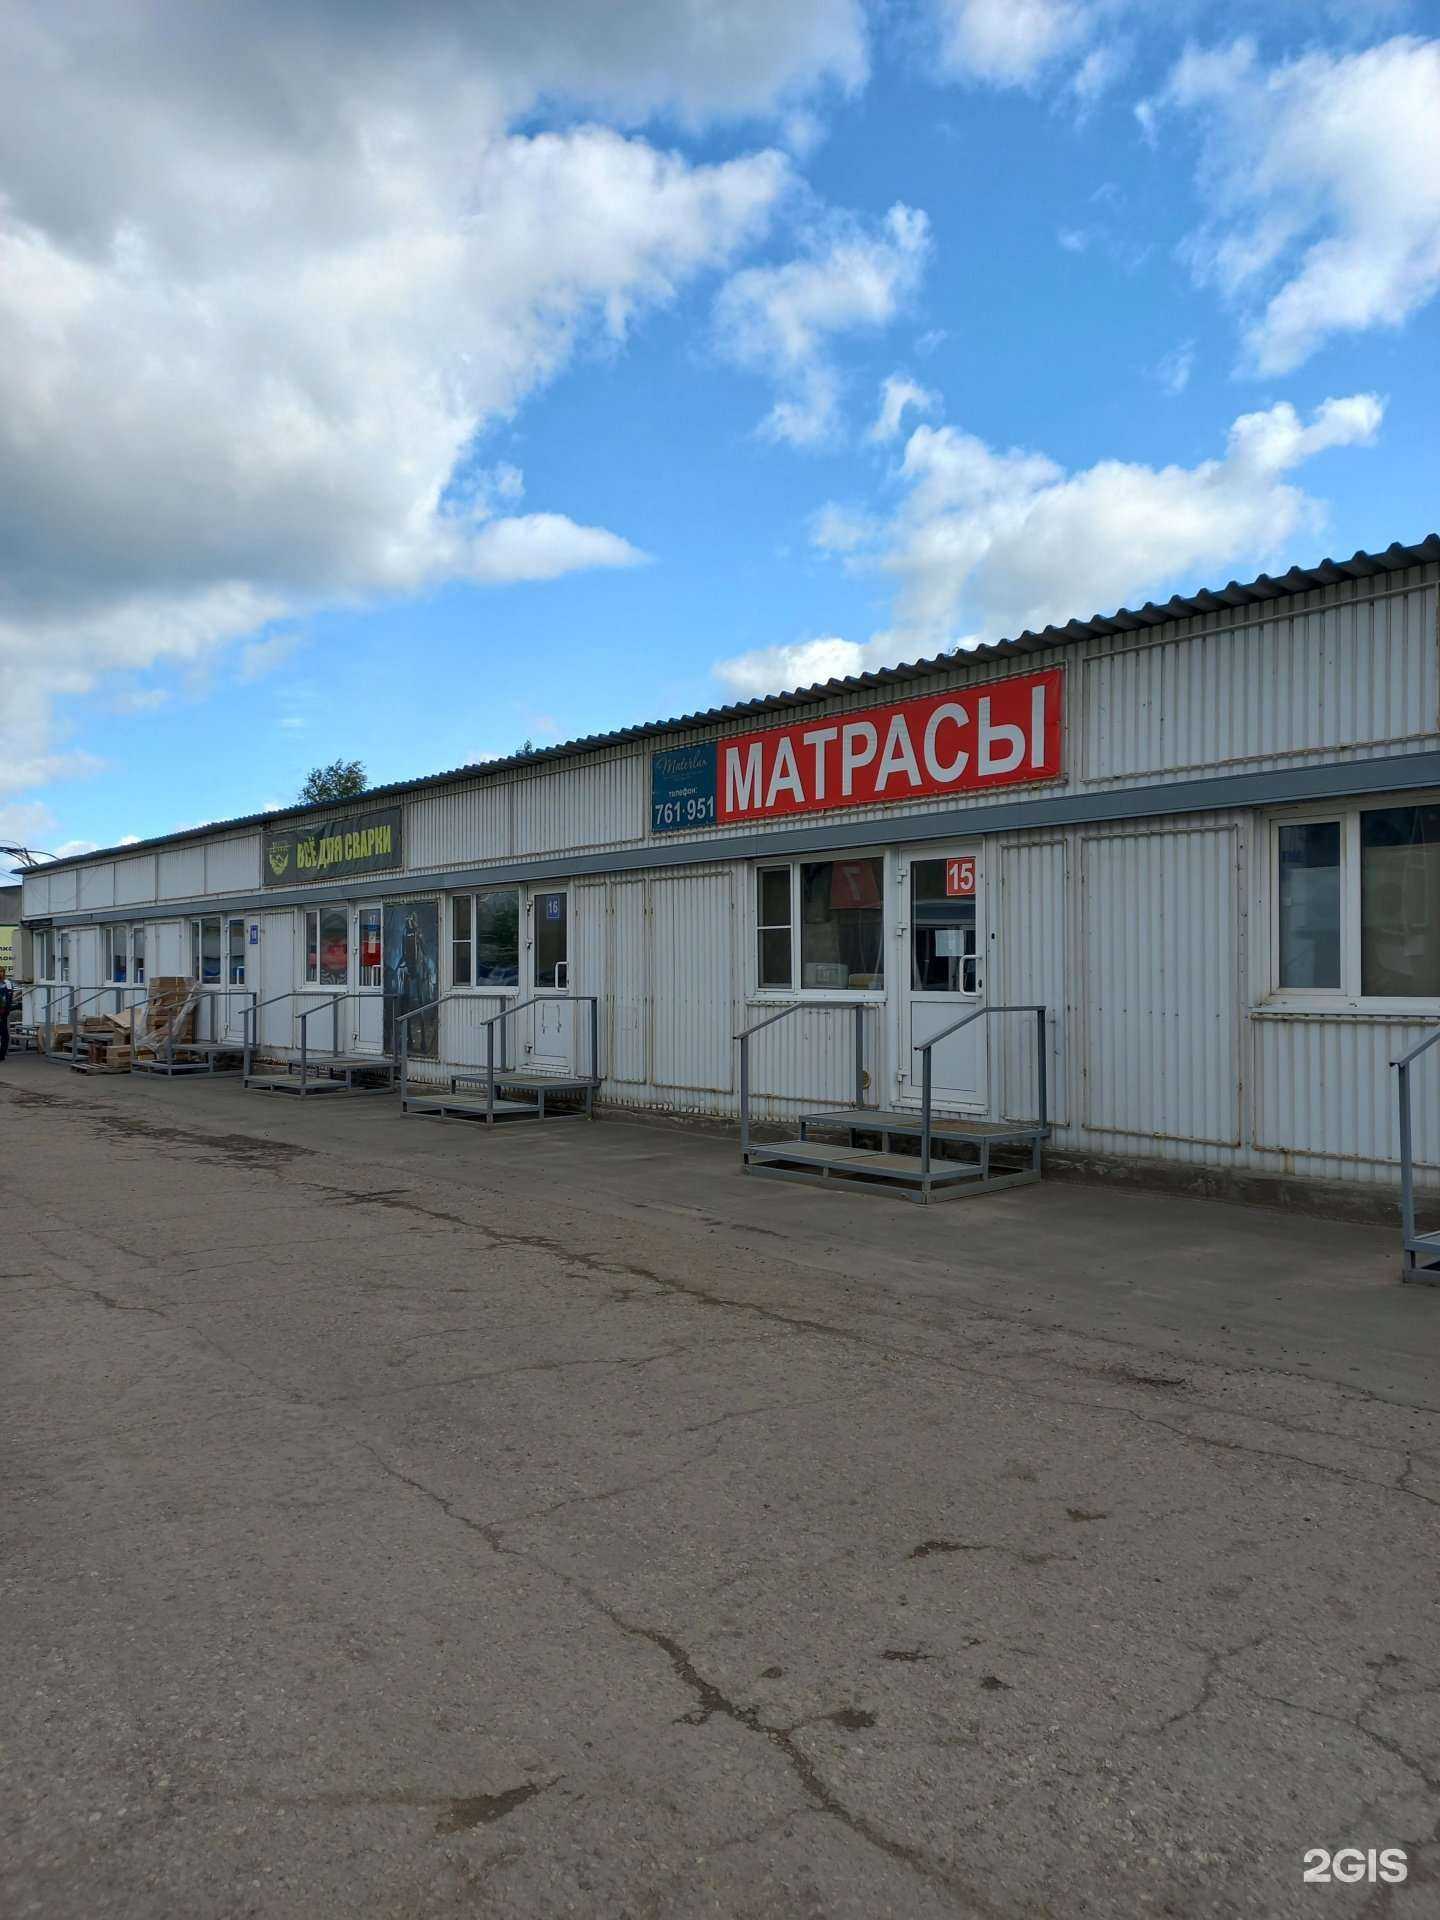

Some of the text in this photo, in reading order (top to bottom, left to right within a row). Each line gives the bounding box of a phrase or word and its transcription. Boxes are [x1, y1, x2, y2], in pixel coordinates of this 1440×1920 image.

[725, 685, 1046, 813] МАТРАСЫ
[297, 825, 391, 870] ВСЁ ДЛЯ СВАРКИ
[949, 862, 974, 890] 15
[547, 900, 558, 913] 16
